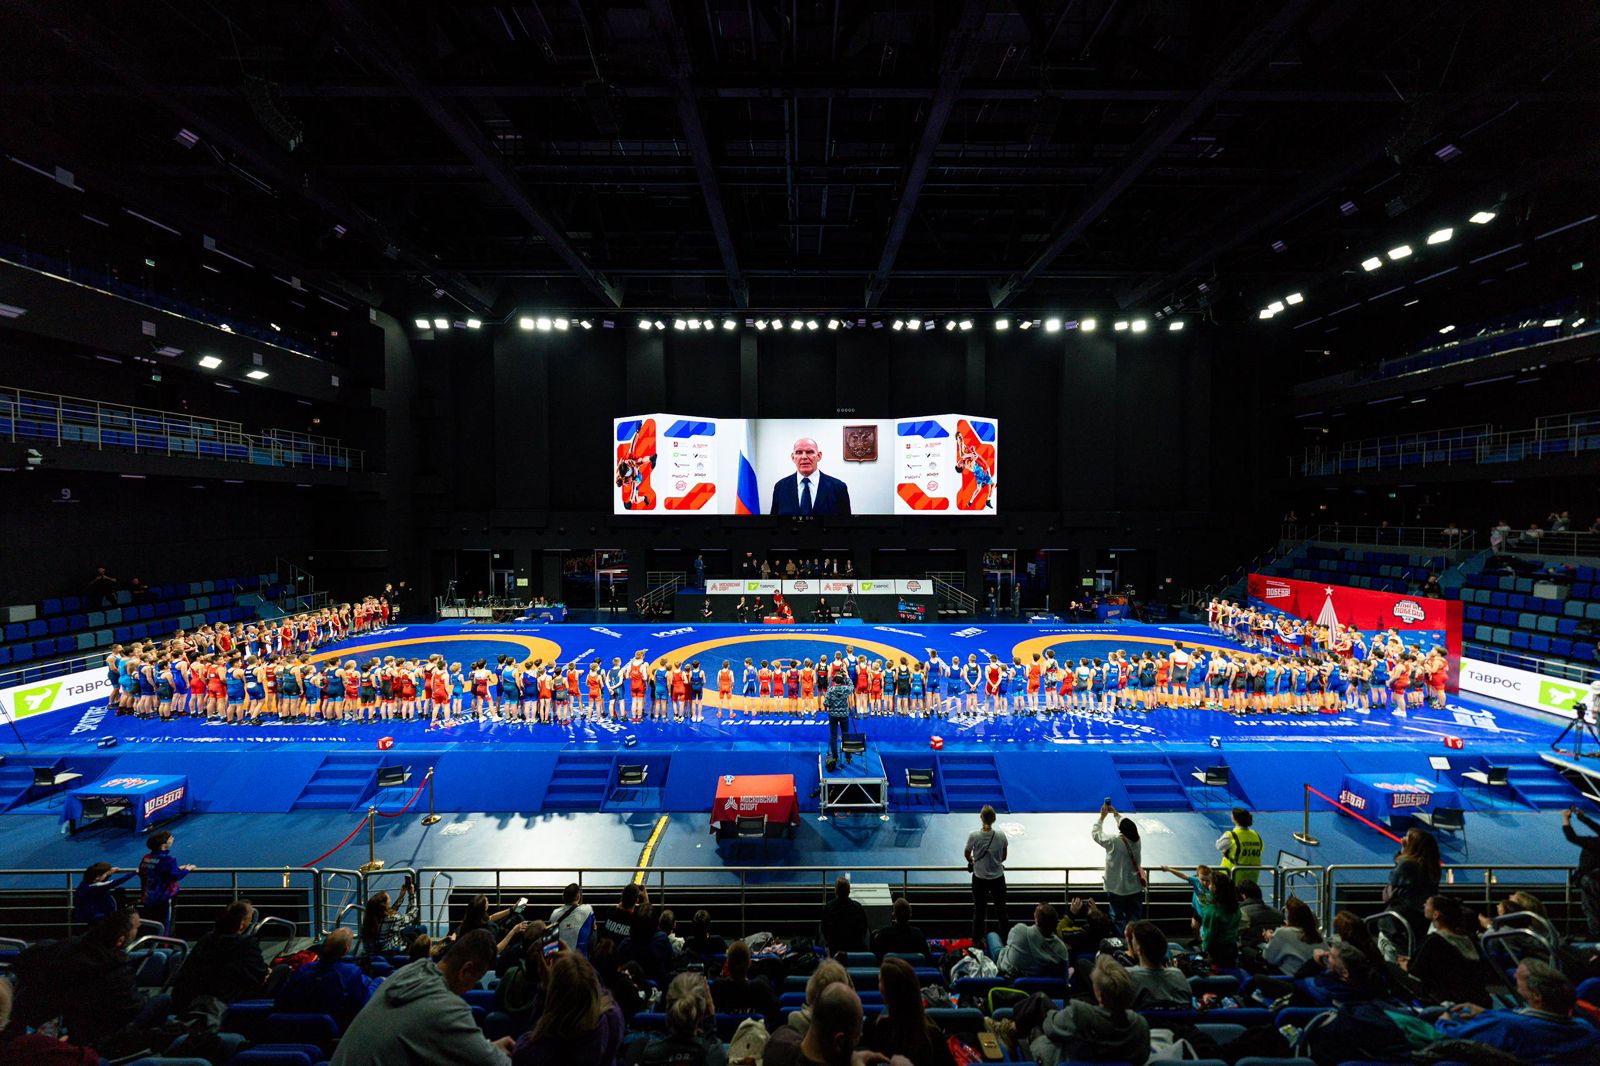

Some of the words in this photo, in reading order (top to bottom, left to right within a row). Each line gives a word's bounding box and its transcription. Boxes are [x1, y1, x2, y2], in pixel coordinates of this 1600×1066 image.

[65, 678, 112, 697] тавро
[740, 794, 779, 804] МОСКОВСКИЙ
[1393, 793, 1430, 808] ПОБЕДА!
[740, 803, 758, 811] СПОРТ
[1242, 848, 1261, 857] 0140
[605, 918, 631, 936] МОСКВ
